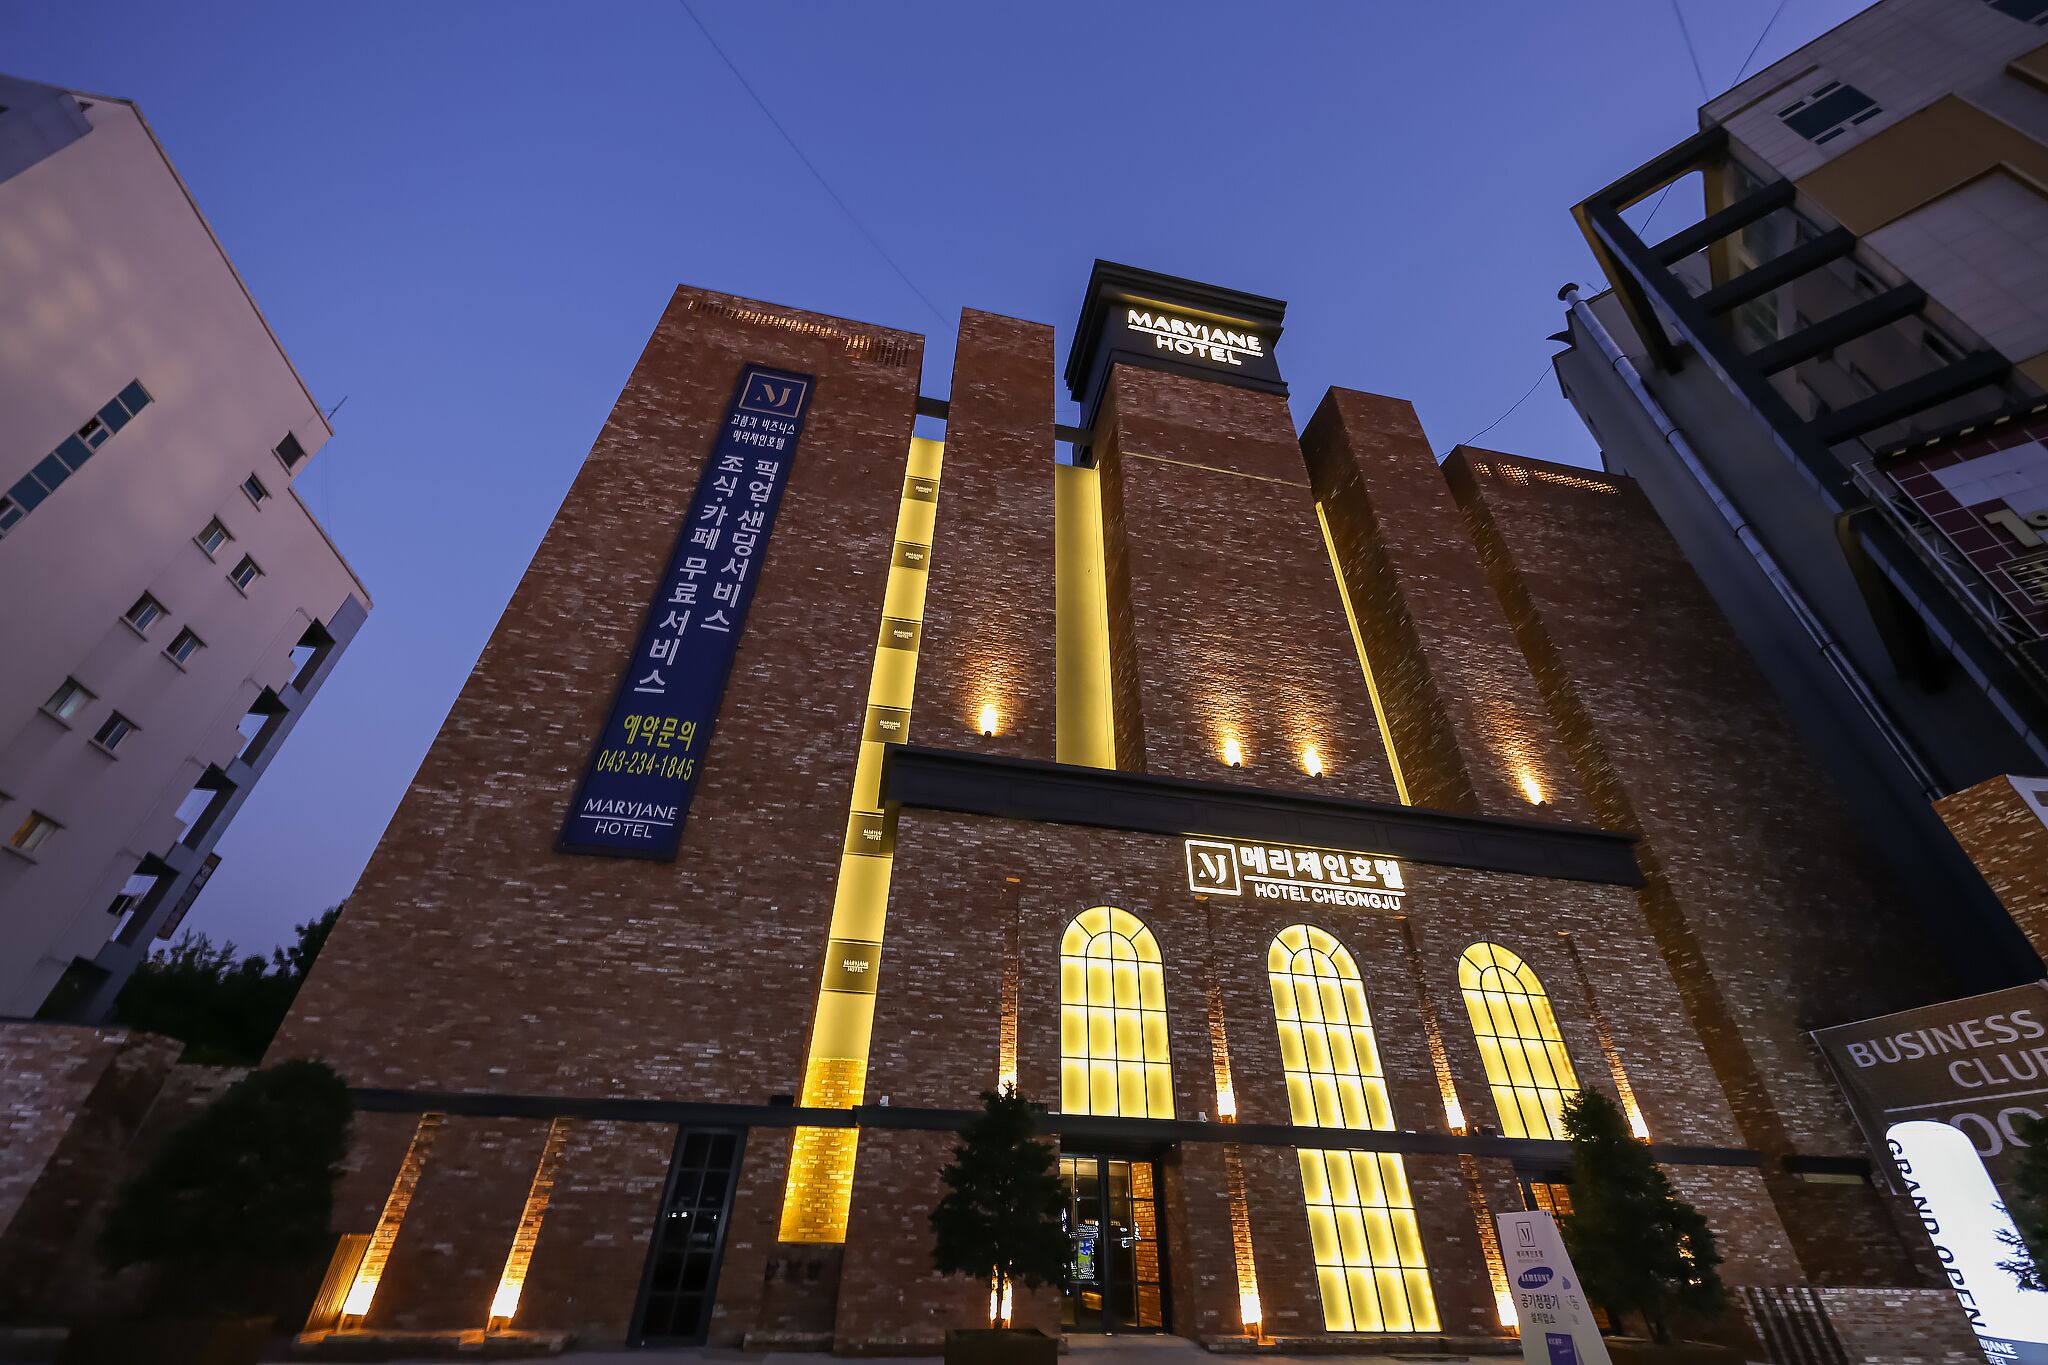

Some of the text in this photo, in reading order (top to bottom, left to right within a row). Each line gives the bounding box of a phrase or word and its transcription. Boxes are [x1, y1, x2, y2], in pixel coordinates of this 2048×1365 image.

[1128, 309, 1262, 351] MARYJANE
[1156, 335, 1242, 366] HOTEL
[761, 418, 796, 436] 비즈니스
[624, 714, 697, 751] 예약문의
[597, 750, 695, 781] 043-234-1845
[584, 799, 677, 820] MARYJANE
[594, 821, 652, 838] HOTEL
[1240, 846, 1405, 890] 메리제인호텔
[1254, 882, 1401, 911] HOTEL CHEONGJU
[1847, 1009, 2045, 1069] BUSINESS
[1887, 1138, 1988, 1328] GRAND OPEN
[1521, 1293, 1560, 1310] 공기청정기
